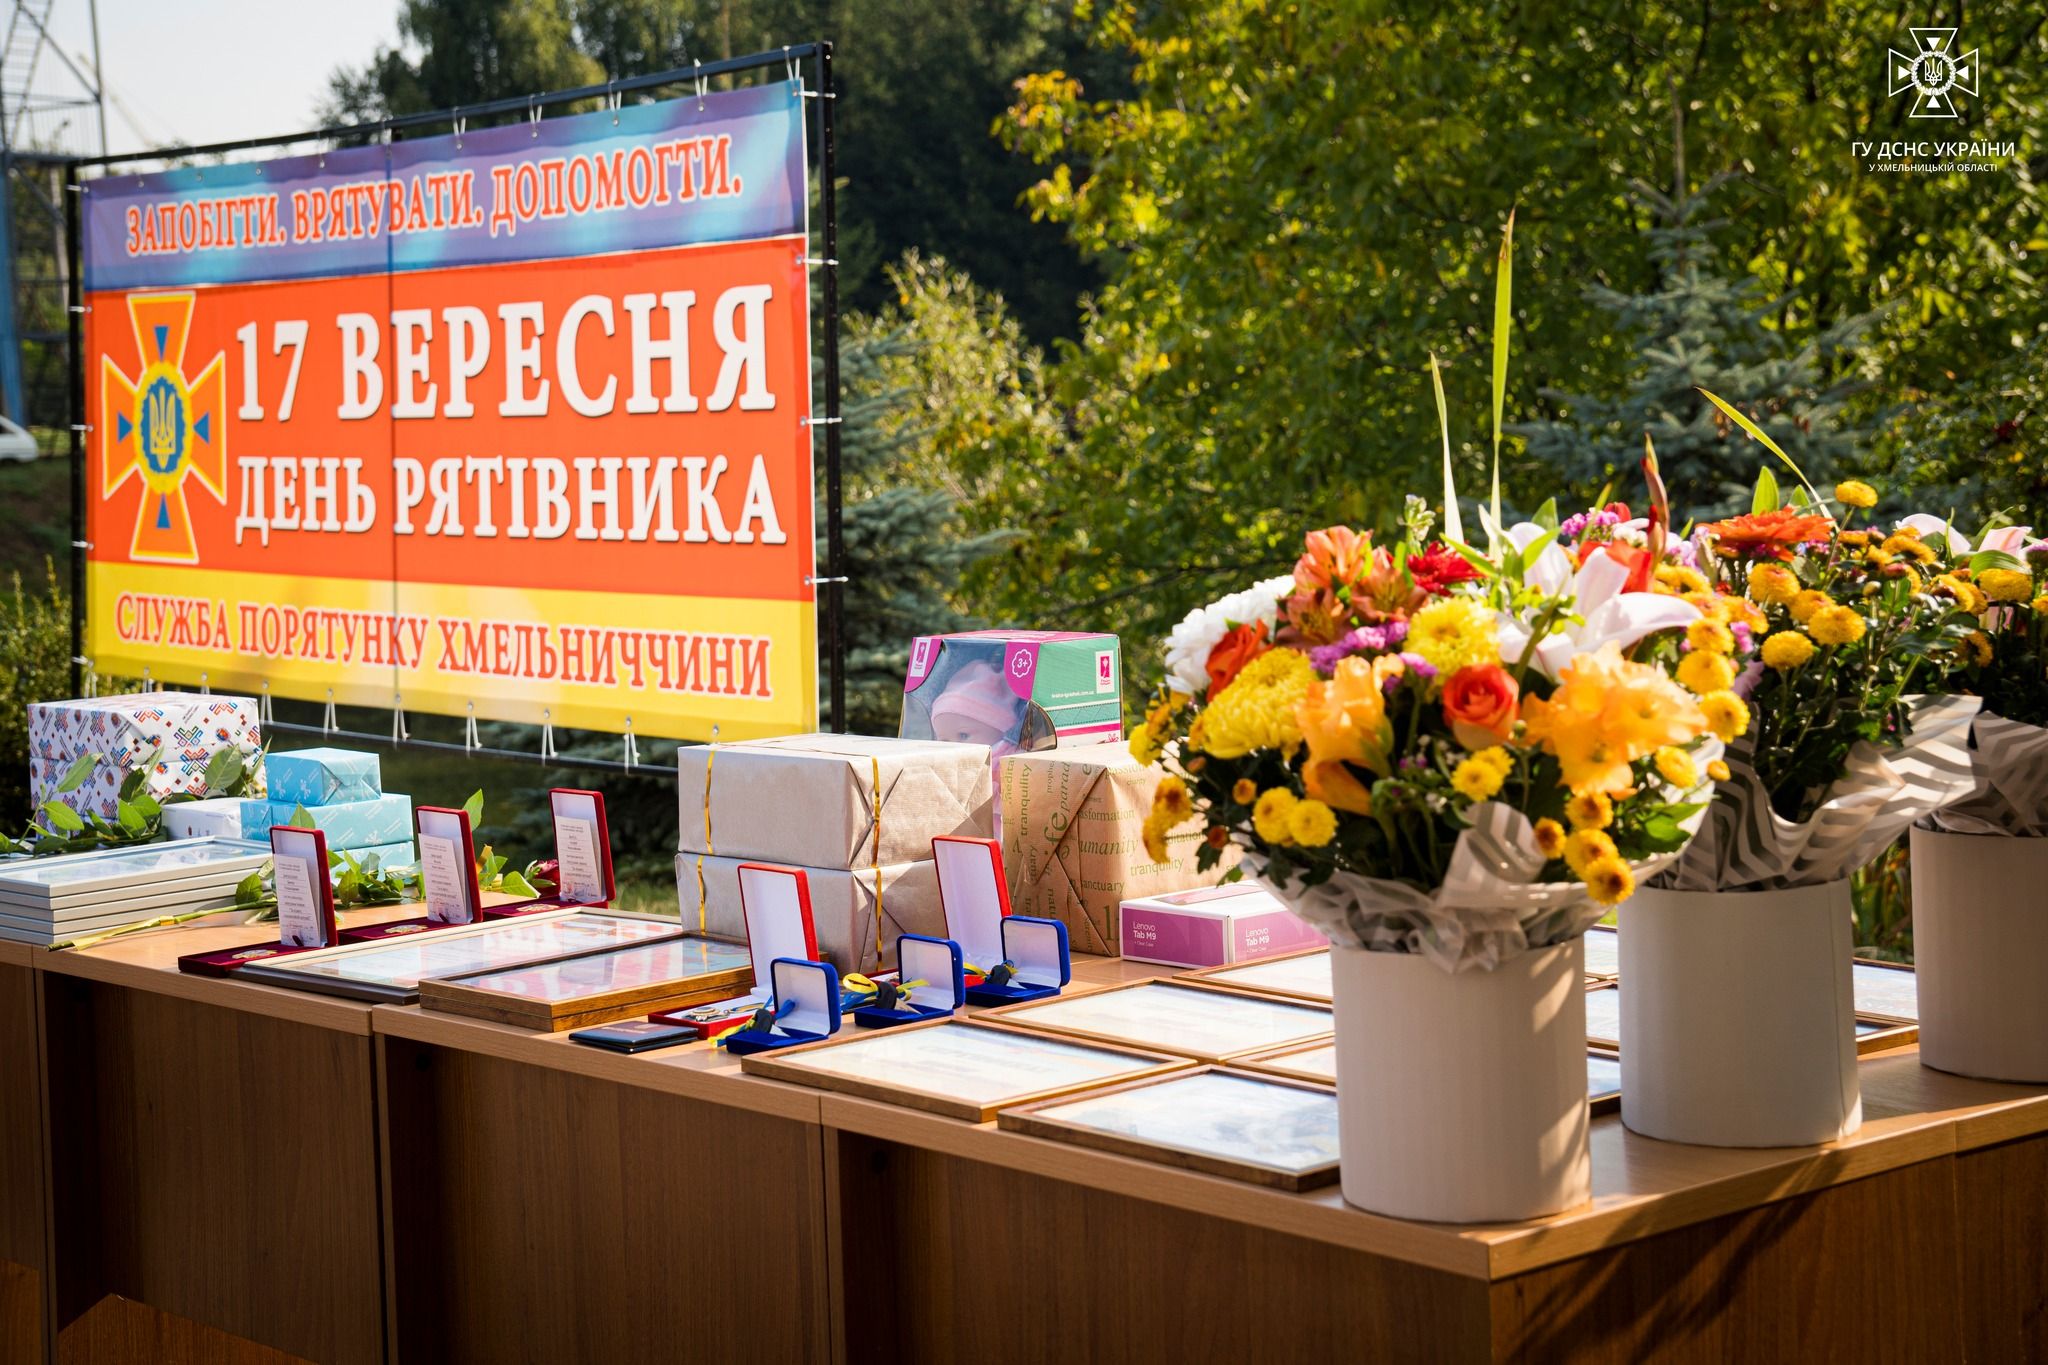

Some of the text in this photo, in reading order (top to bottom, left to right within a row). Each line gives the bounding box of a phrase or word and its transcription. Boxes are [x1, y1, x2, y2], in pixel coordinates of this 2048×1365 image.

[127, 134, 743, 256] ЗАПОБІГТИ. ВРЯТУВАТИ. ДОПОМОГТИ.
[236, 283, 777, 423] 17 ВЕРЕСНЯ
[235, 453, 788, 547] ДЕНЬ РЯТІВНИКА
[115, 592, 772, 698] СЛУЖБА ПОРЯТУНКУ ХМЕЛЬНИЧЧИНИ
[1017, 657, 1029, 669] 3+
[1020, 763, 1033, 836] tranquility
[1078, 837, 1139, 858] umanity
[1132, 920, 1156, 932] Lenovo
[1133, 930, 1157, 941] Tab M9
[1245, 927, 1269, 938] Lenovo
[1246, 935, 1270, 947] Tab M9
